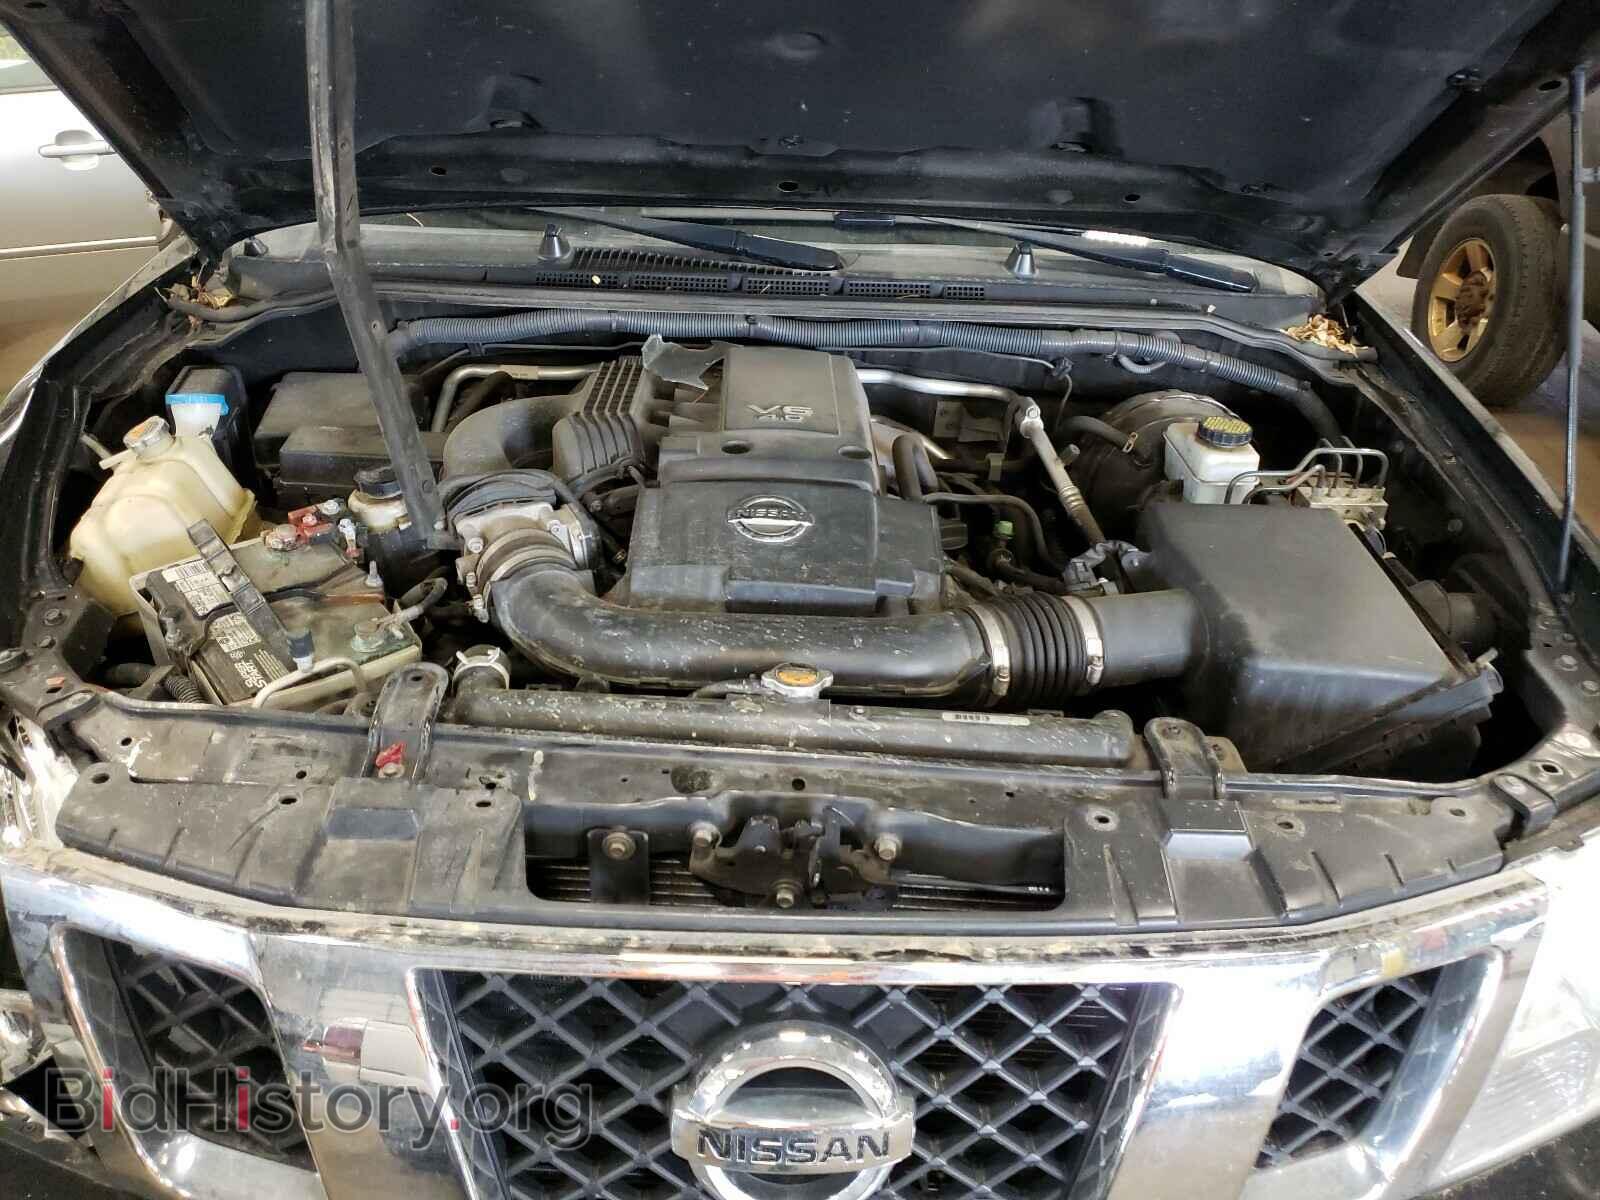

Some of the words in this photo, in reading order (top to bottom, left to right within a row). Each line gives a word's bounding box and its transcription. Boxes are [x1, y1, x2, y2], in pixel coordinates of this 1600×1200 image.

[234, 661, 254, 688] SUPER
[241, 659, 268, 688] START
[697, 1128, 892, 1165] NISSAN
